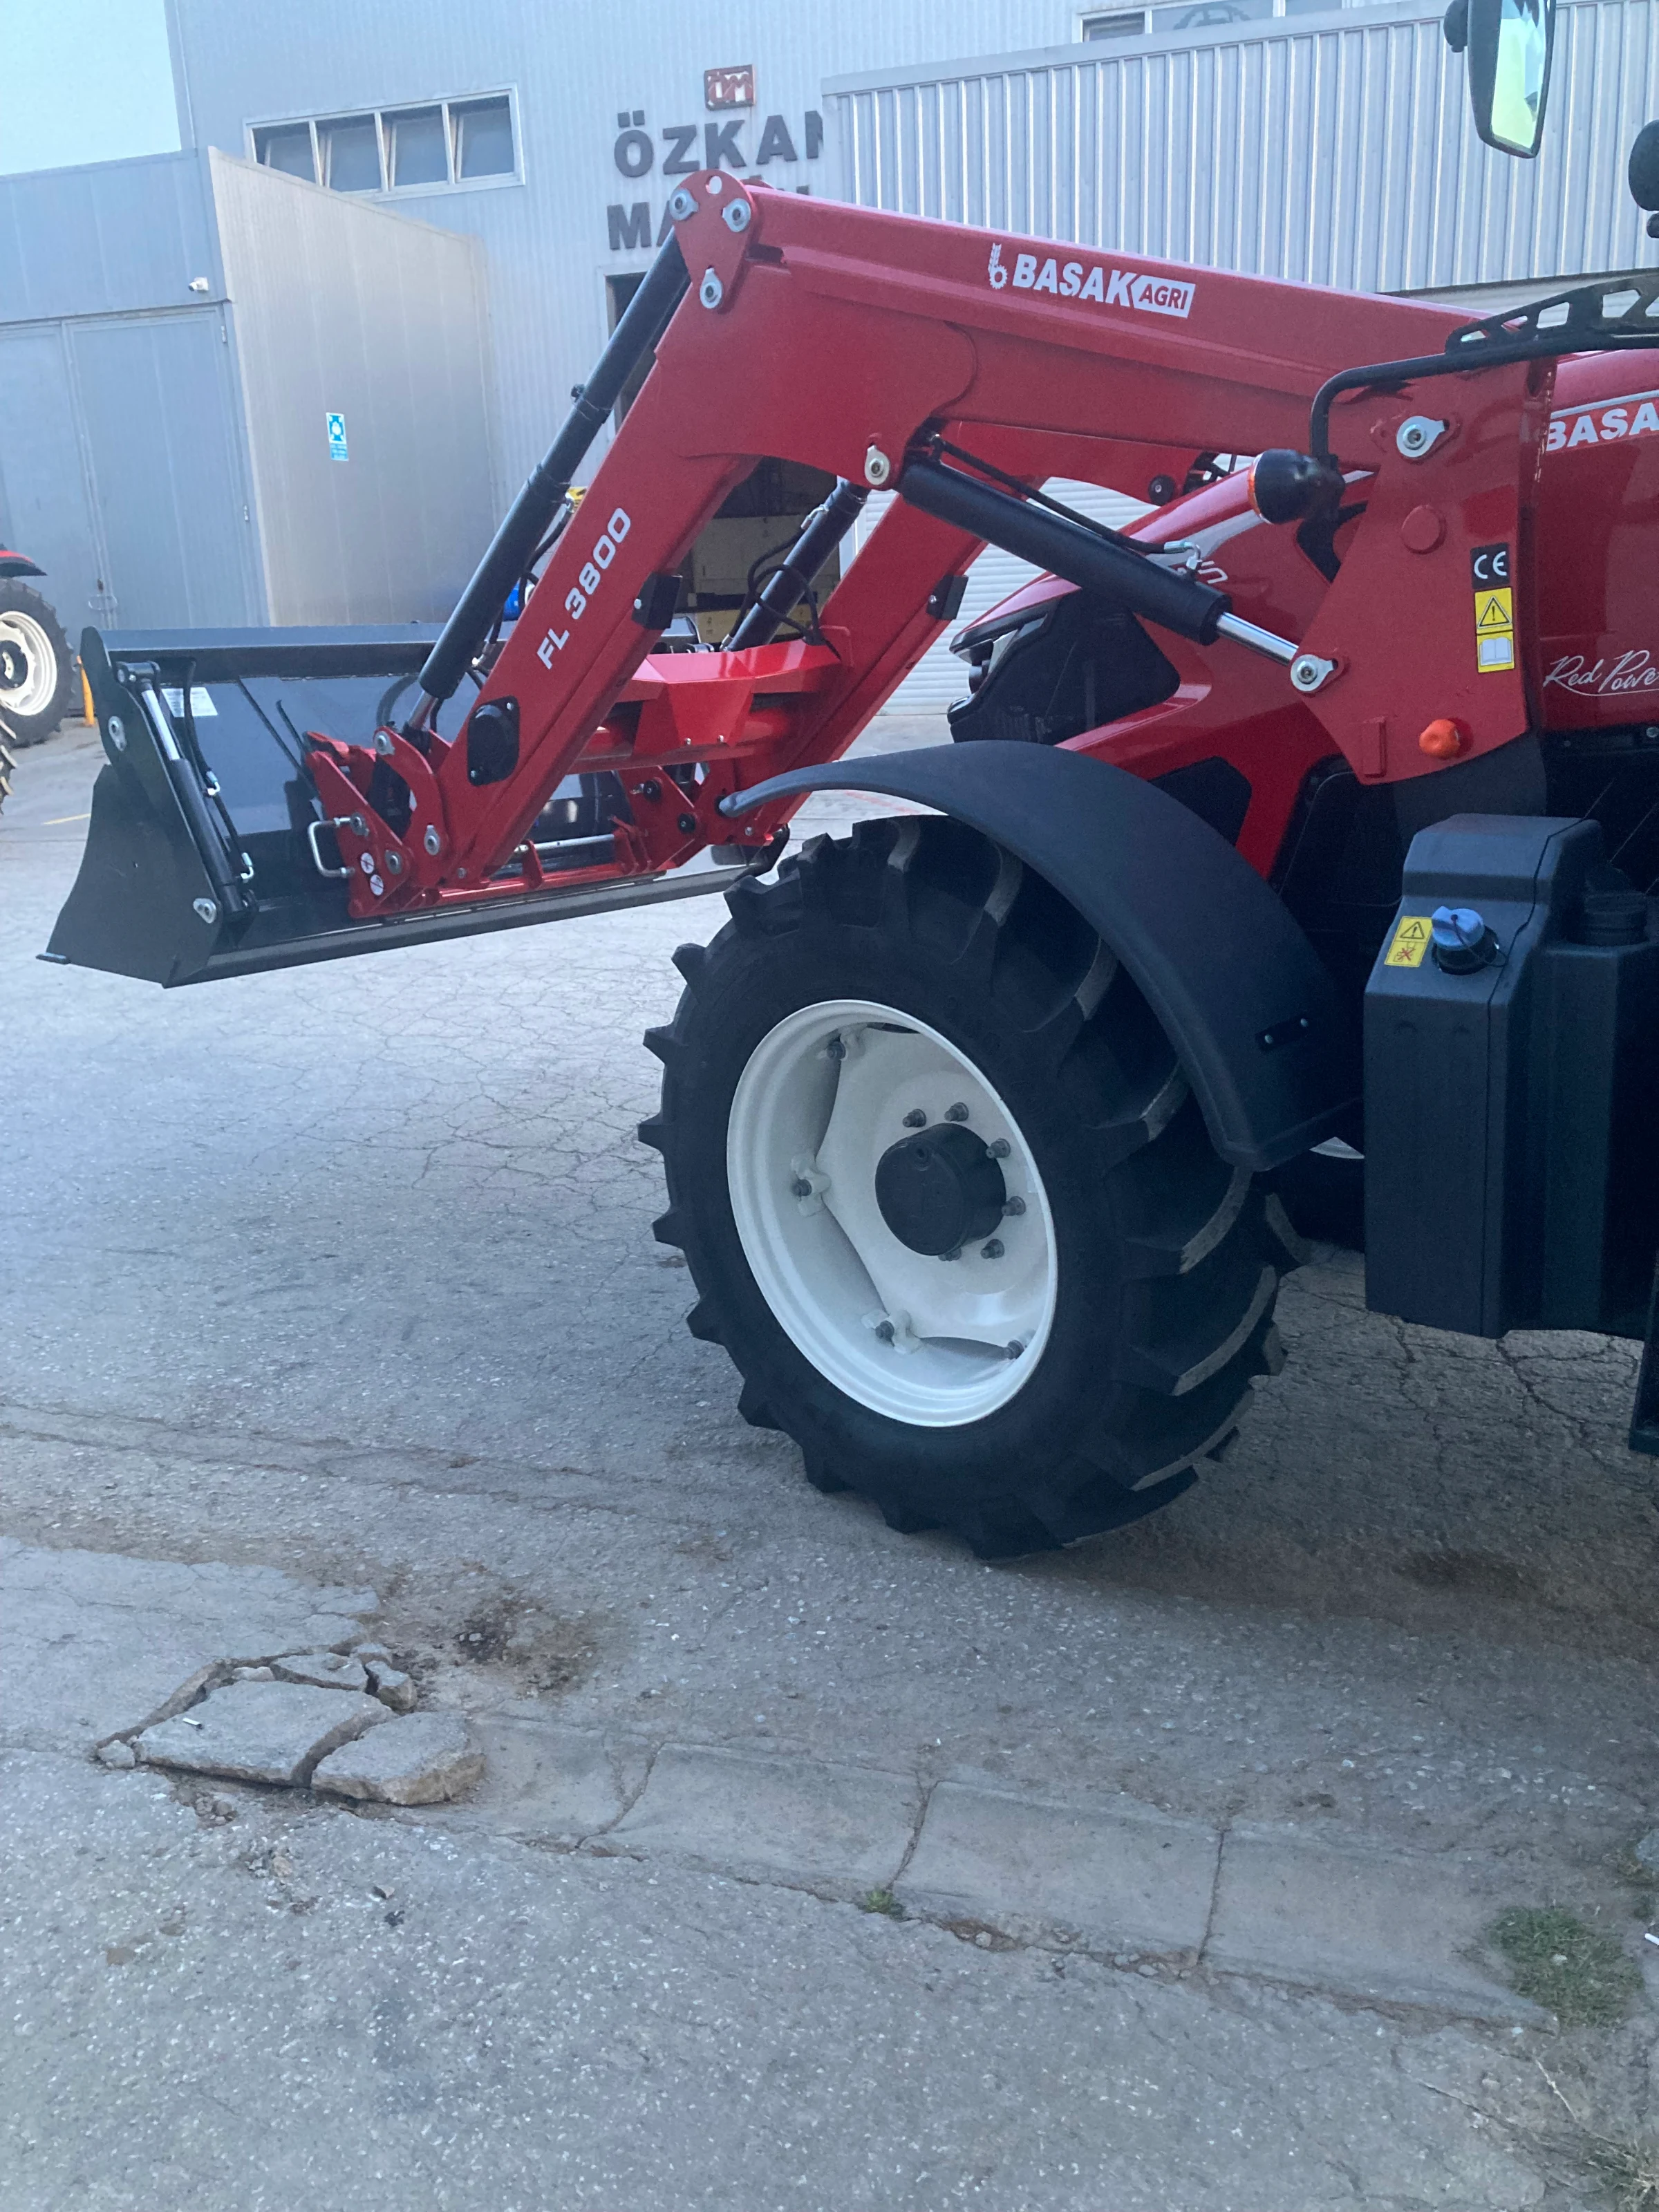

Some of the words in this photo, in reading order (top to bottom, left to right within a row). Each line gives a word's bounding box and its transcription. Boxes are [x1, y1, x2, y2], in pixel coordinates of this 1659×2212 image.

[1012, 253, 1136, 307] BASAK
[1138, 283, 1188, 310] AGRI
[1546, 402, 1659, 451] BASA
[537, 628, 570, 670] FL
[565, 507, 631, 619] 3800
[1474, 551, 1507, 579] CE
[1542, 655, 1604, 688] Red
[1598, 650, 1659, 693] Powe
